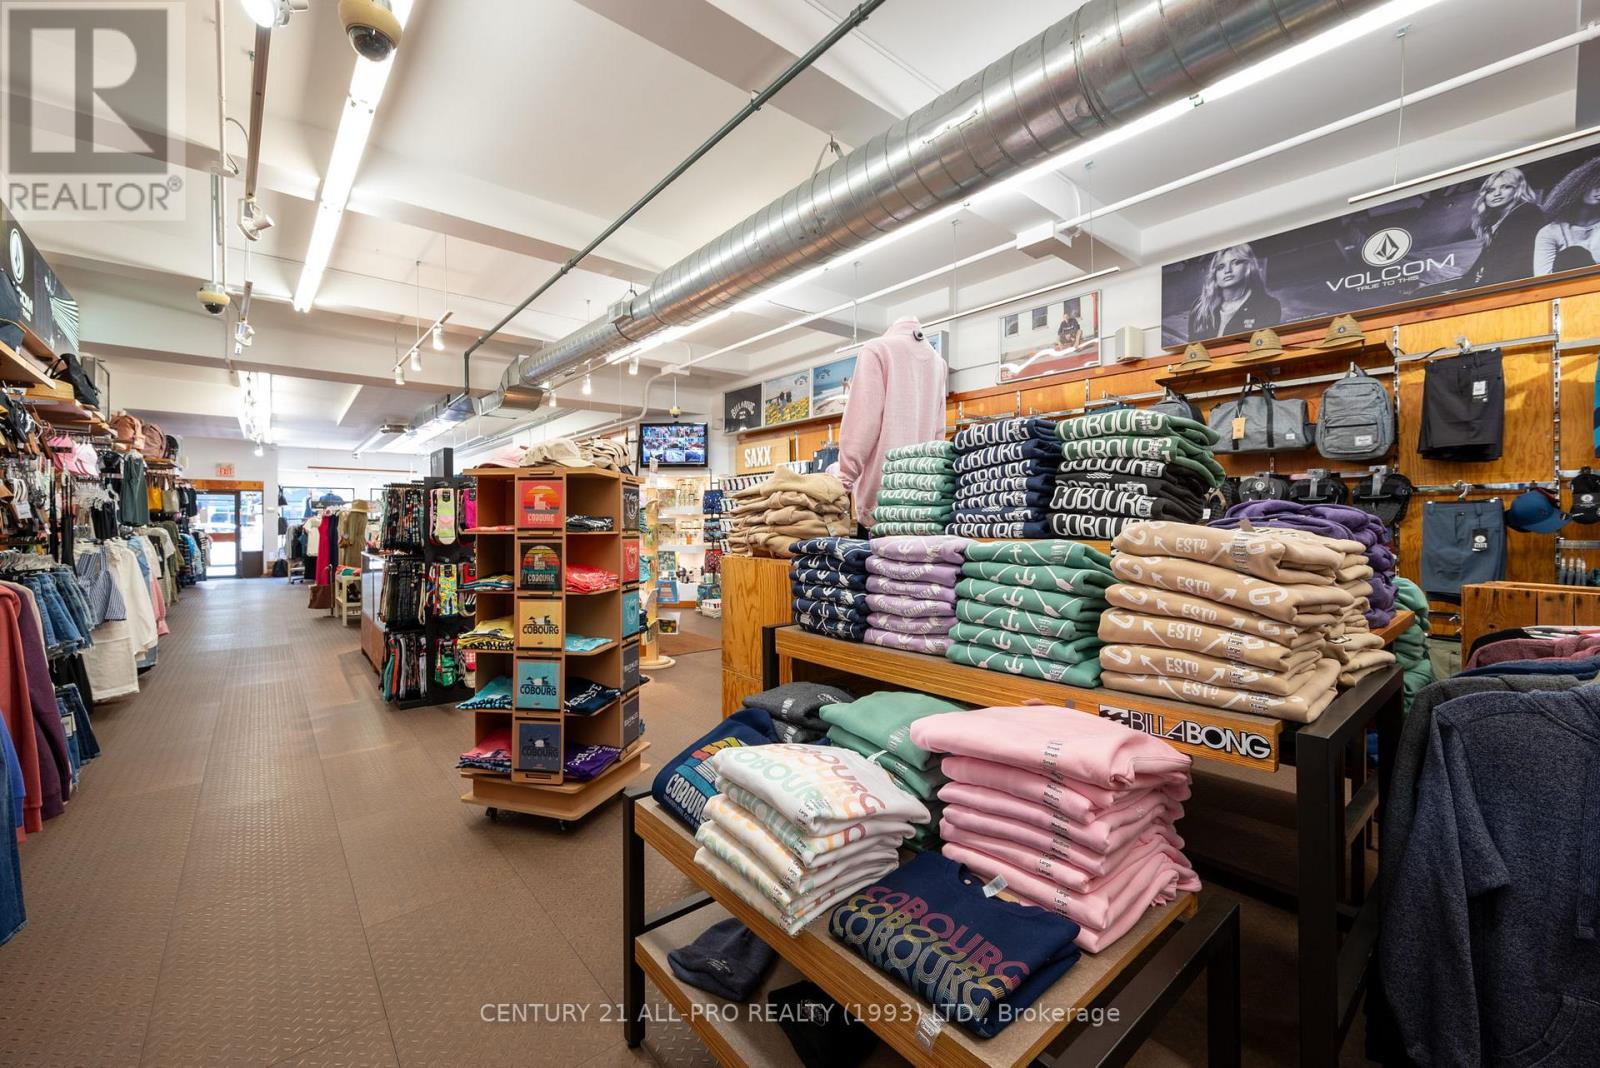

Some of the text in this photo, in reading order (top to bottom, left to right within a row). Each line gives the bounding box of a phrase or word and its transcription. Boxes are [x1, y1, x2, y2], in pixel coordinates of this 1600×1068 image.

[1326, 253, 1456, 292] VOLCOM
[1356, 283, 1379, 292] TRUE
[1399, 275, 1419, 283] THIS
[954, 417, 1031, 450] COBOURG
[744, 445, 771, 468] SAXX
[952, 440, 1025, 474] COBOURG
[522, 623, 560, 635] COBOURG
[520, 683, 557, 696] COBOURG
[1129, 709, 1272, 760] BILLABONG
[665, 773, 711, 824] COBOUR
[866, 886, 1030, 990] COBOURG
